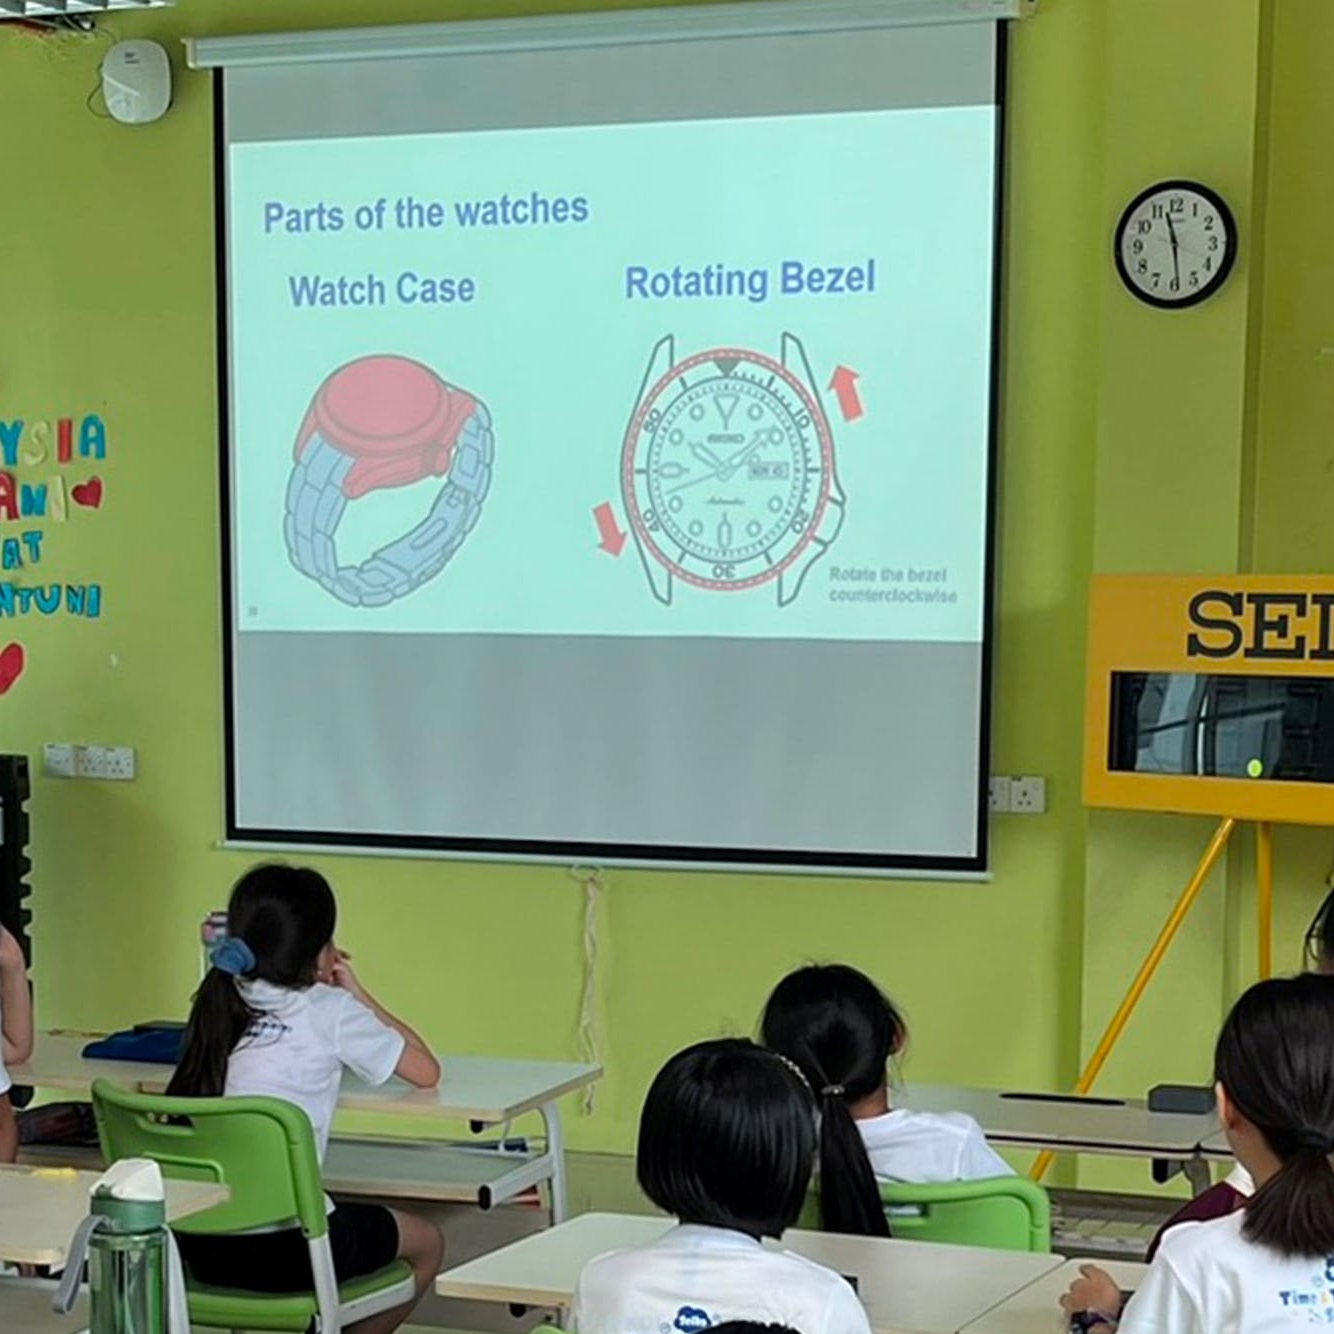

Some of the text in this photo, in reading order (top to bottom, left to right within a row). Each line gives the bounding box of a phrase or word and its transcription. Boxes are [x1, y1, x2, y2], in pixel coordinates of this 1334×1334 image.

[265, 192, 589, 233] Parts of the watches
[1152, 204, 1163, 219] 11
[1170, 199, 1184, 213] 12
[1192, 203, 1198, 217] 1
[1138, 219, 1152, 235] 10
[1204, 215, 1214, 231] 2
[1133, 239, 1144, 255] 9
[1208, 236, 1218, 251] 3
[1138, 259, 1148, 274] 8
[1202, 255, 1211, 271] 4
[626, 258, 876, 303] Rotating Bezel
[1151, 272, 1161, 288] 7
[1189, 271, 1198, 287] 5
[288, 272, 476, 307] Watch Case
[829, 566, 947, 582] Rotate the bezel
